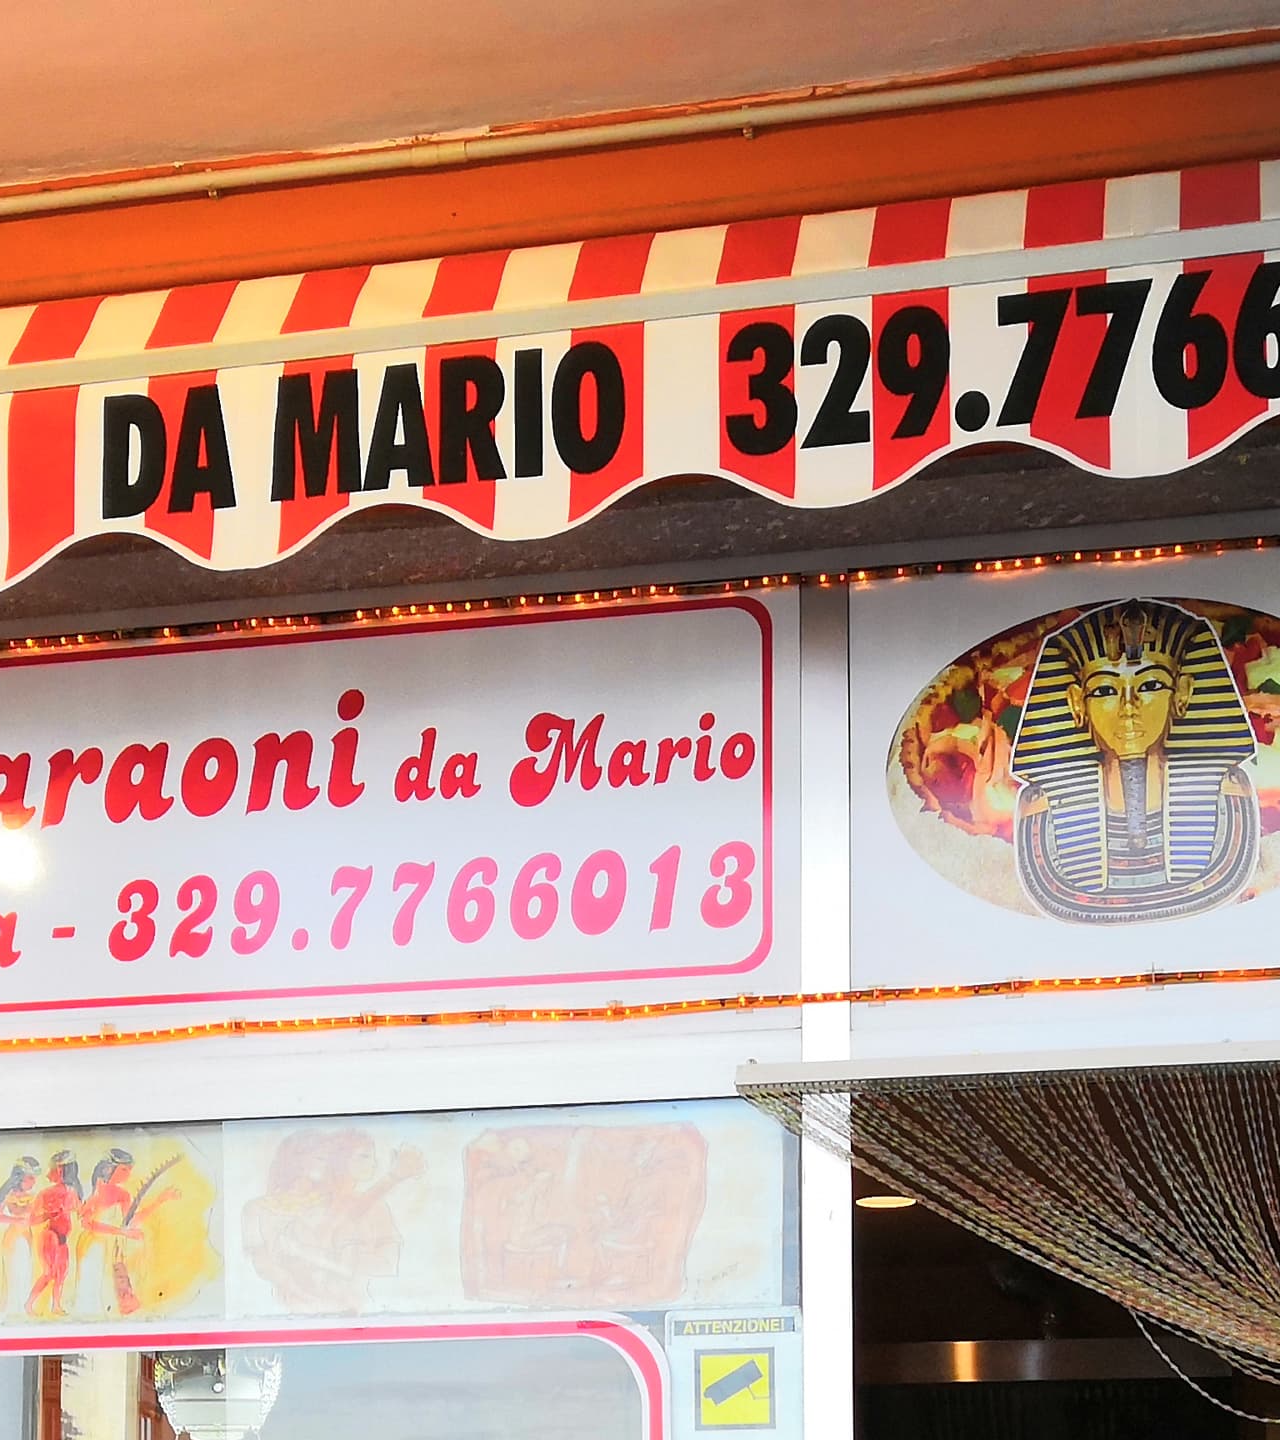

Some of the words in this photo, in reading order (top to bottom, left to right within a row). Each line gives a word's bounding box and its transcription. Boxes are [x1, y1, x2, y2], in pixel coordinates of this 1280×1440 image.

[102, 385, 236, 519] DA
[270, 341, 627, 502] MARIO
[394, 727, 481, 801] da
[510, 712, 756, 807] Mario
[108, 840, 756, 962] 329.7766013
[683, 1318, 785, 1335] ATTENZIONE!
